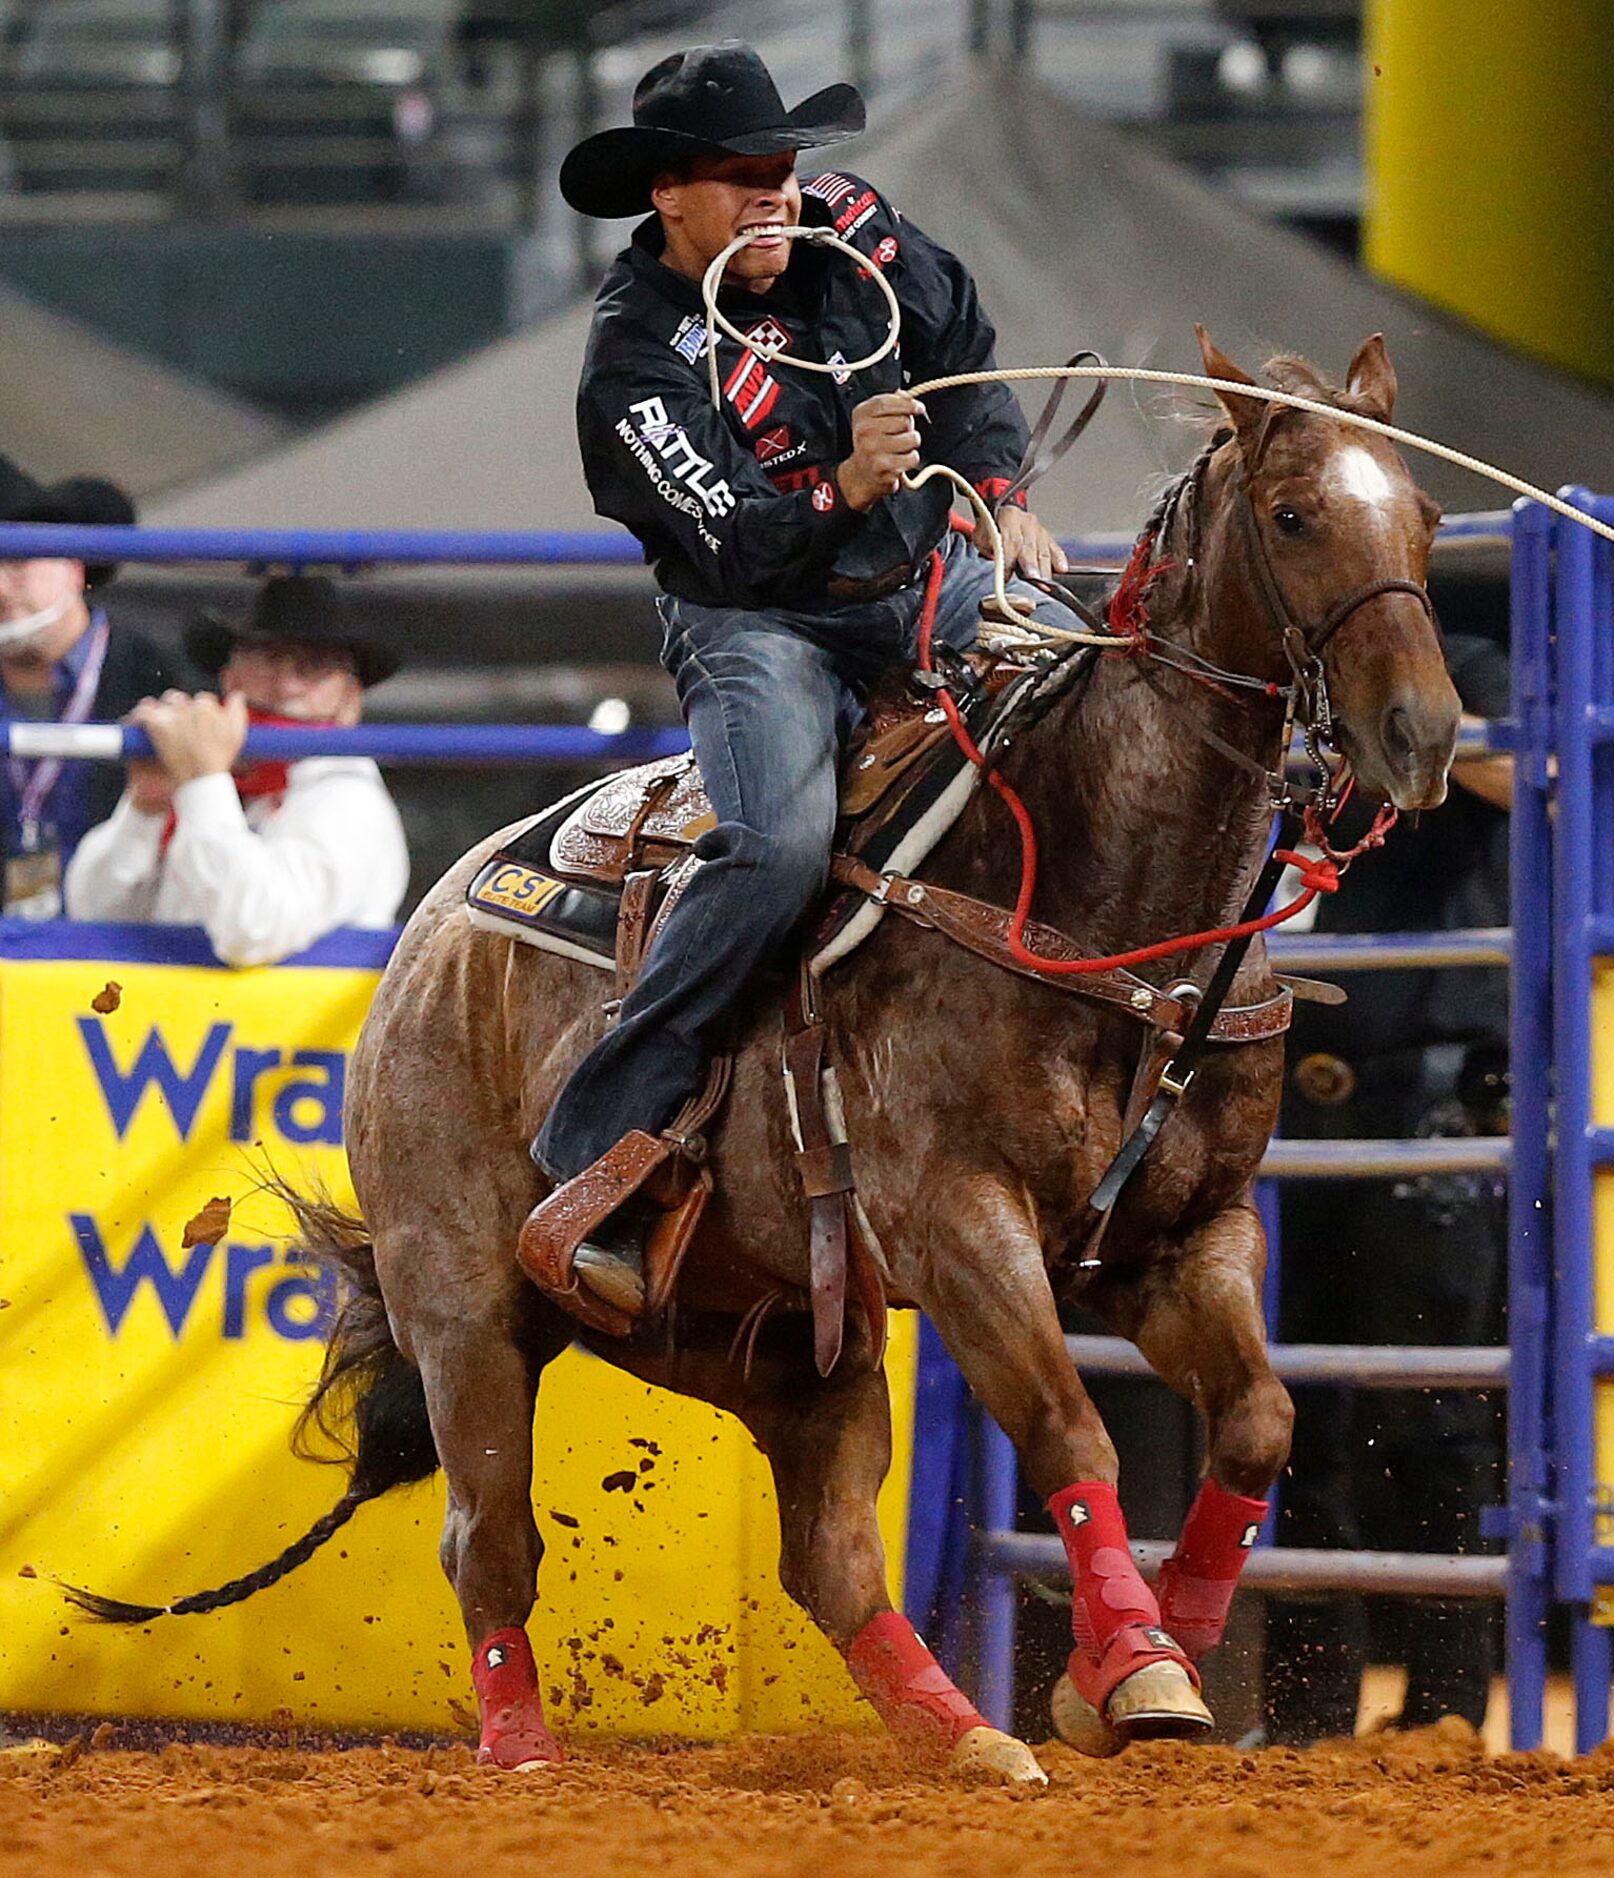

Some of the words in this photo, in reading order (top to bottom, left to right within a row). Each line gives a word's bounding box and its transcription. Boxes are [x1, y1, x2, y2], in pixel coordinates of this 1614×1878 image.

[615, 418, 659, 484] NOTHING
[657, 480, 703, 519] COMES
[491, 868, 560, 906] CSI
